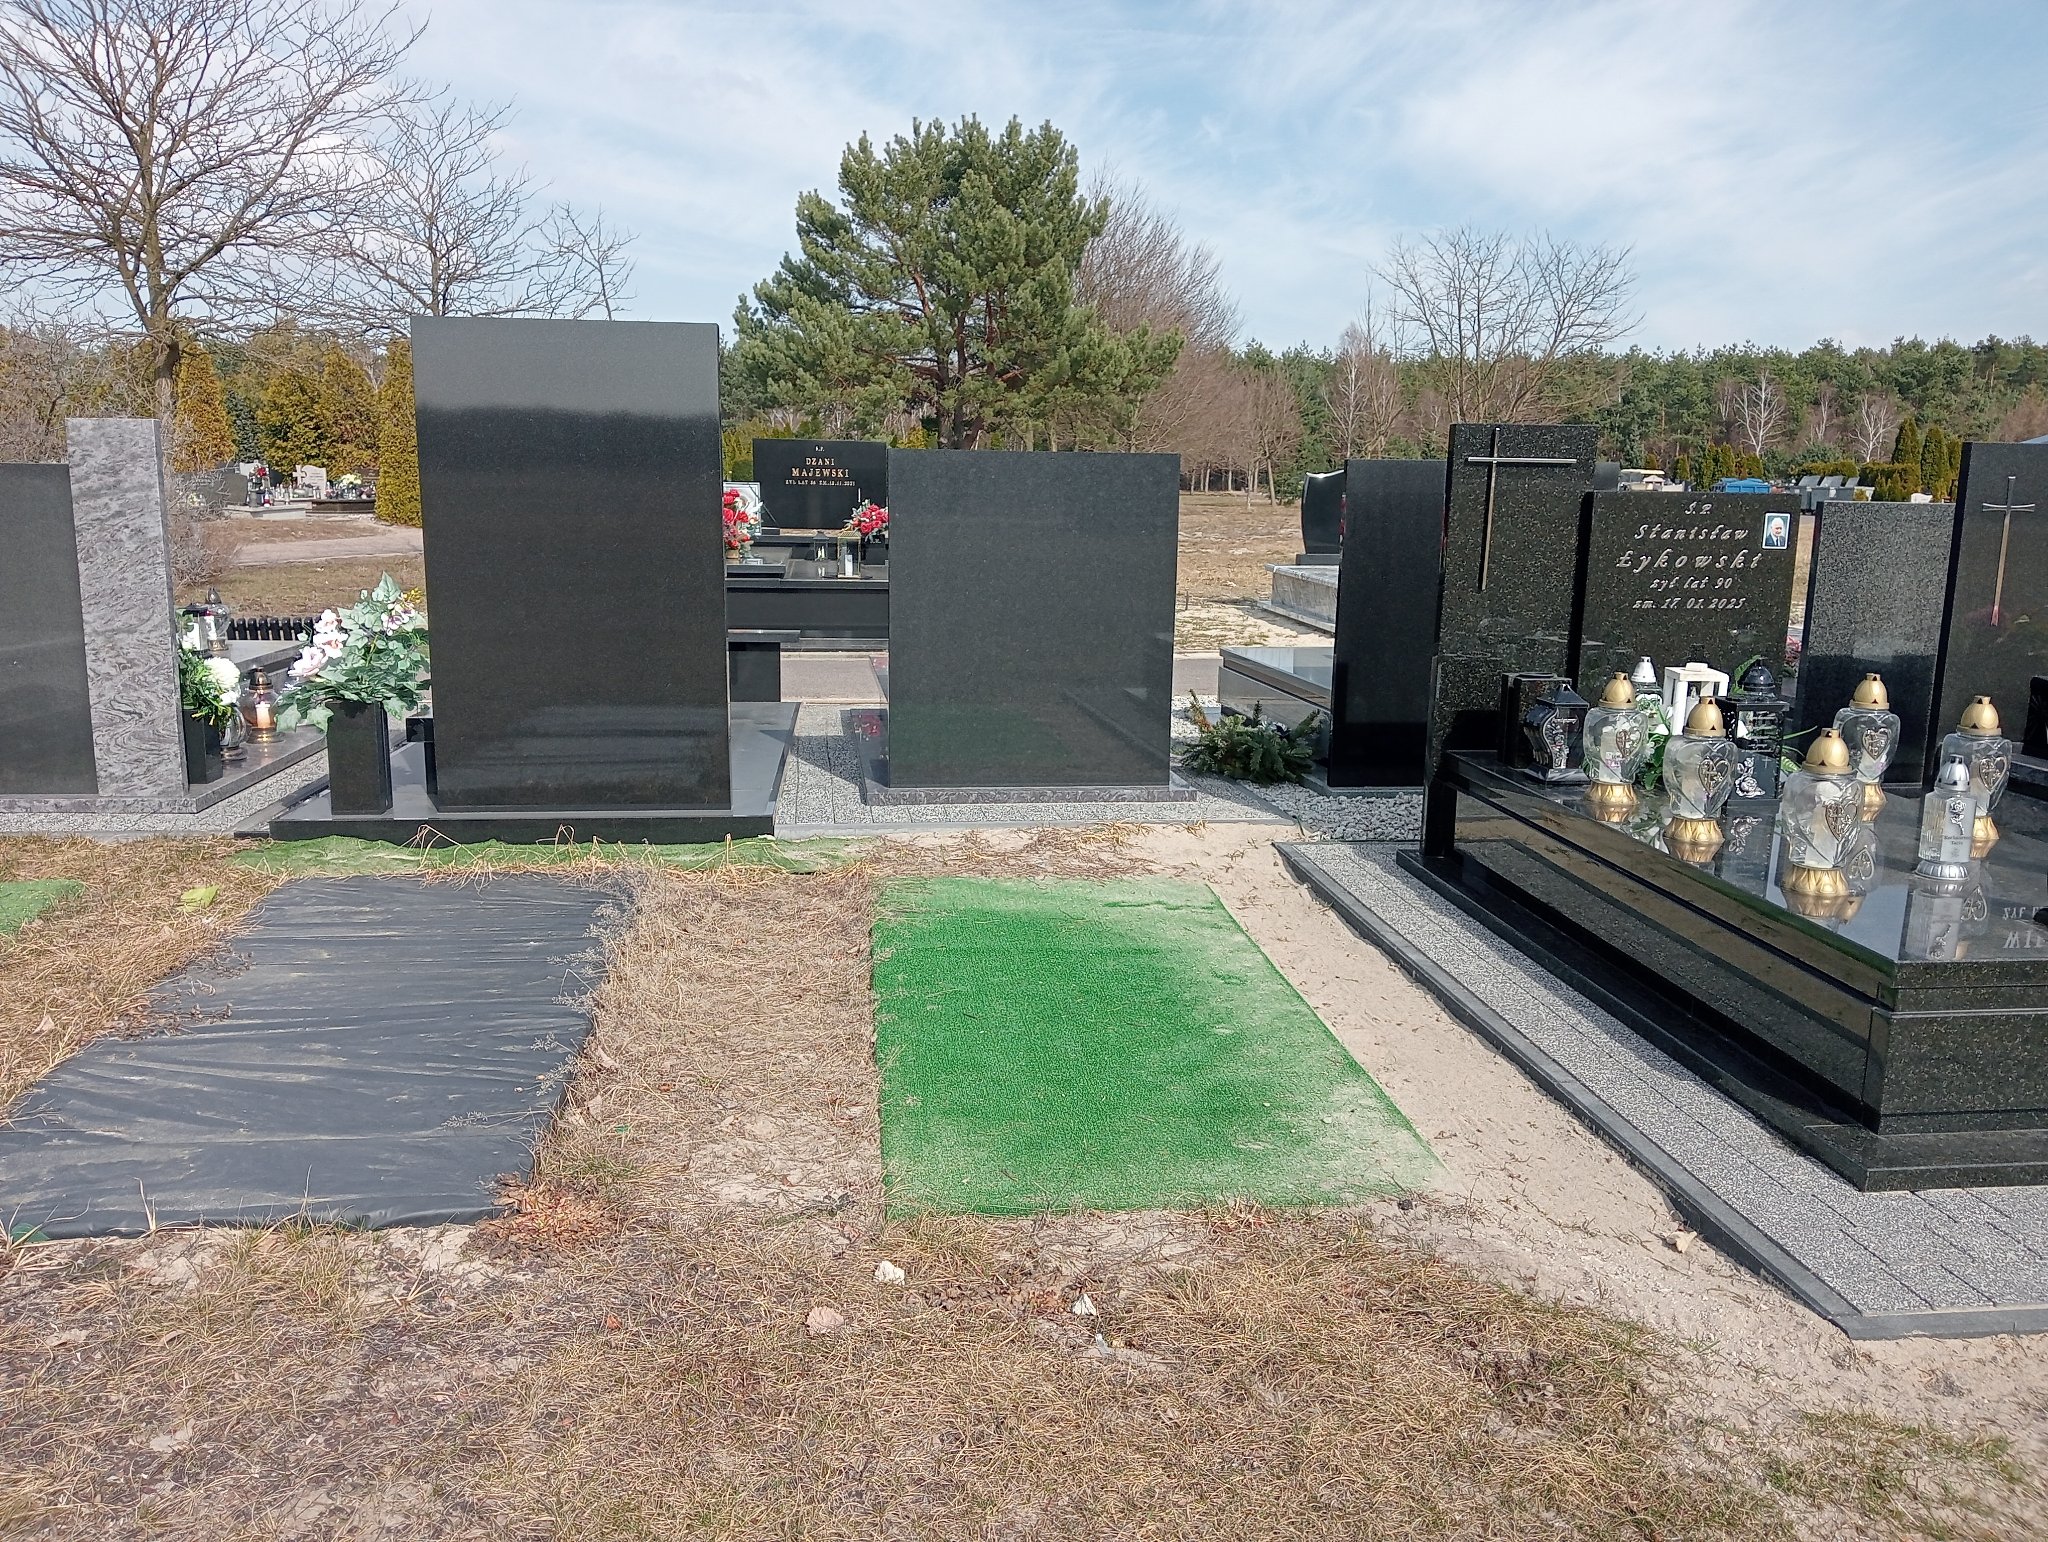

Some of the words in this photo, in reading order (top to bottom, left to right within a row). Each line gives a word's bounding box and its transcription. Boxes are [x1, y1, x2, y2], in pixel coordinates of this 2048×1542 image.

[791, 467, 850, 478] MAJEWSKI
[1633, 522, 1749, 541] Stanisław
[1615, 548, 1763, 574] Łykowski
[1683, 576, 1710, 589] lat
[1714, 576, 1733, 589] 90
[1632, 599, 1657, 609] zm.
[1708, 597, 1747, 609] 2025
